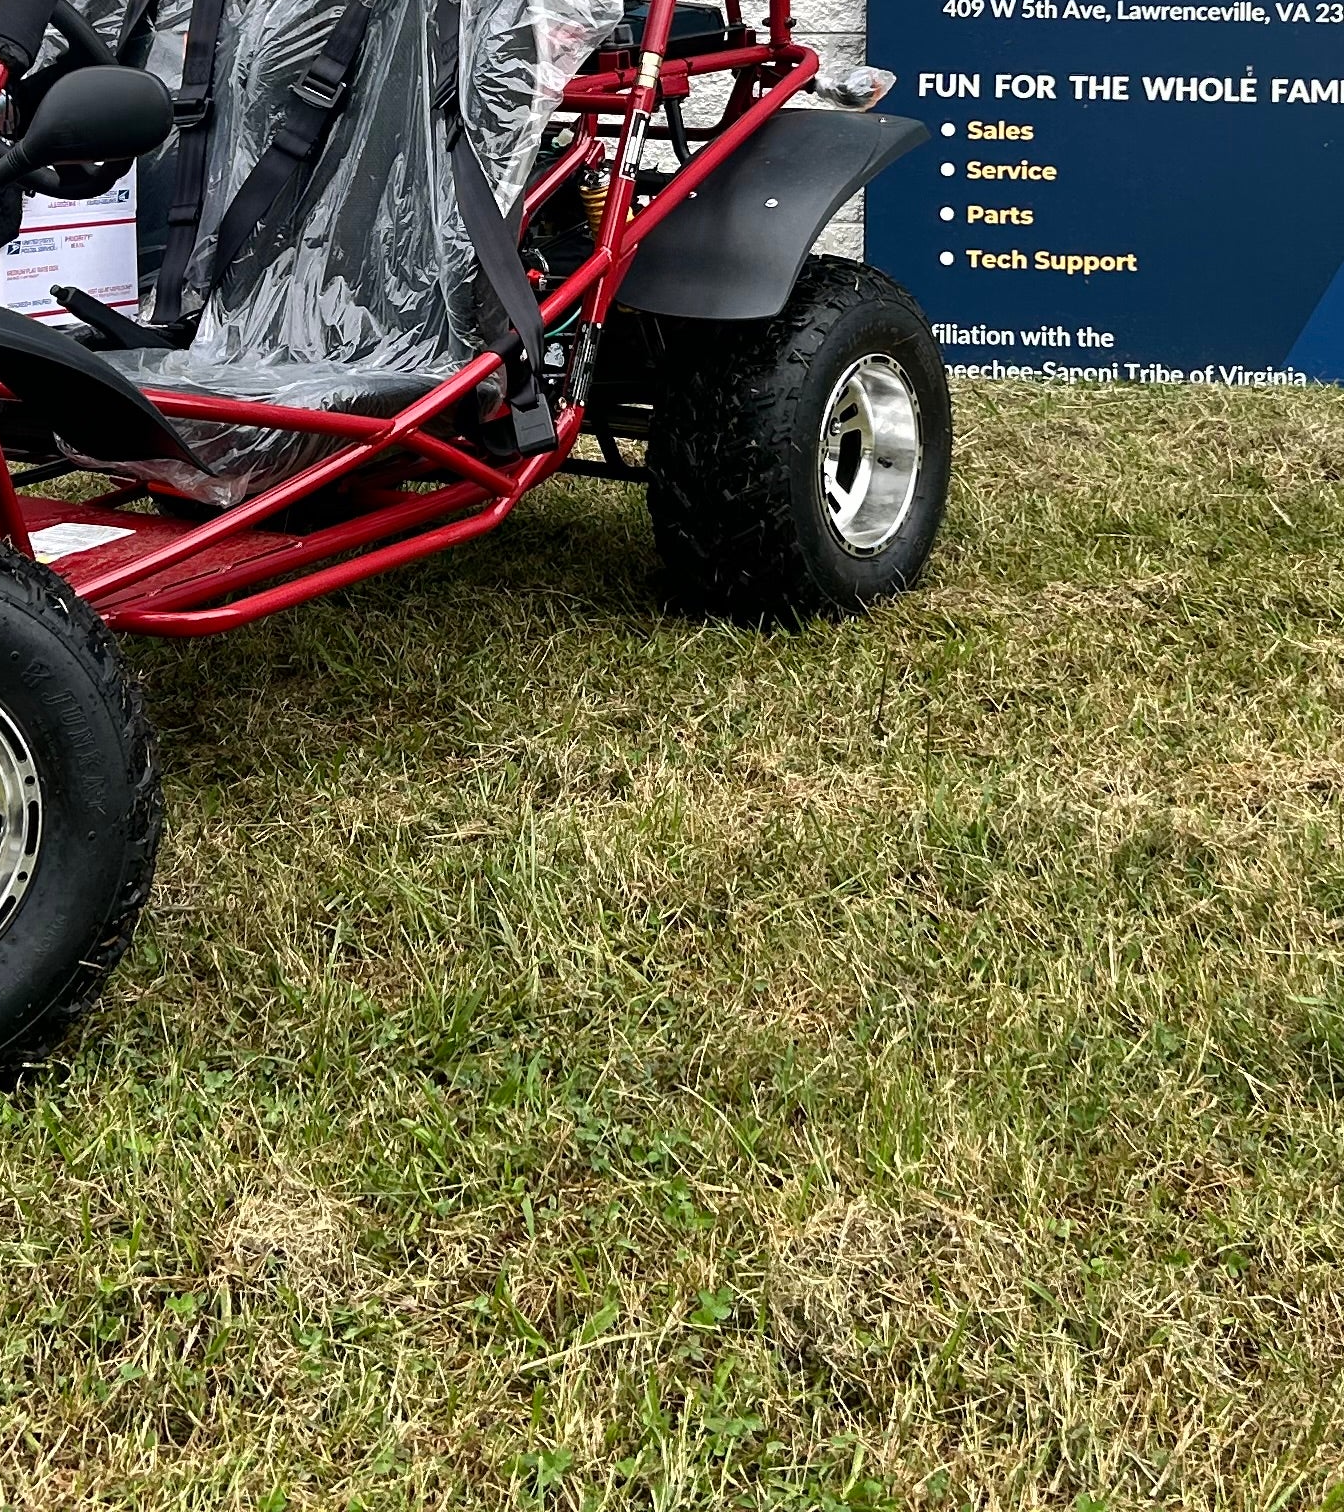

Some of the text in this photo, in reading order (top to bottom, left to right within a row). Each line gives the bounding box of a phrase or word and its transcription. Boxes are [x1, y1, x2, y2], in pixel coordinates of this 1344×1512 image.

[1021, 0, 1058, 20] 5th
[1062, 0, 1112, 24] Ave,
[1116, 0, 1271, 25] Lawrenceville,
[1276, 3, 1311, 22] VA
[918, 73, 980, 98] FUN
[995, 74, 1057, 100] FOR
[1068, 75, 1130, 101] THE
[1141, 76, 1258, 103] WHOLE
[967, 120, 1034, 141] Sales
[966, 159, 1057, 181] Service
[967, 205, 1034, 225] Parts
[965, 249, 1138, 275] Tech Support
[1020, 325, 1071, 347] with
[1076, 326, 1115, 348] the
[1123, 362, 1185, 385] Tribe
[1189, 363, 1215, 386] of
[1218, 365, 1307, 388] Virginia
